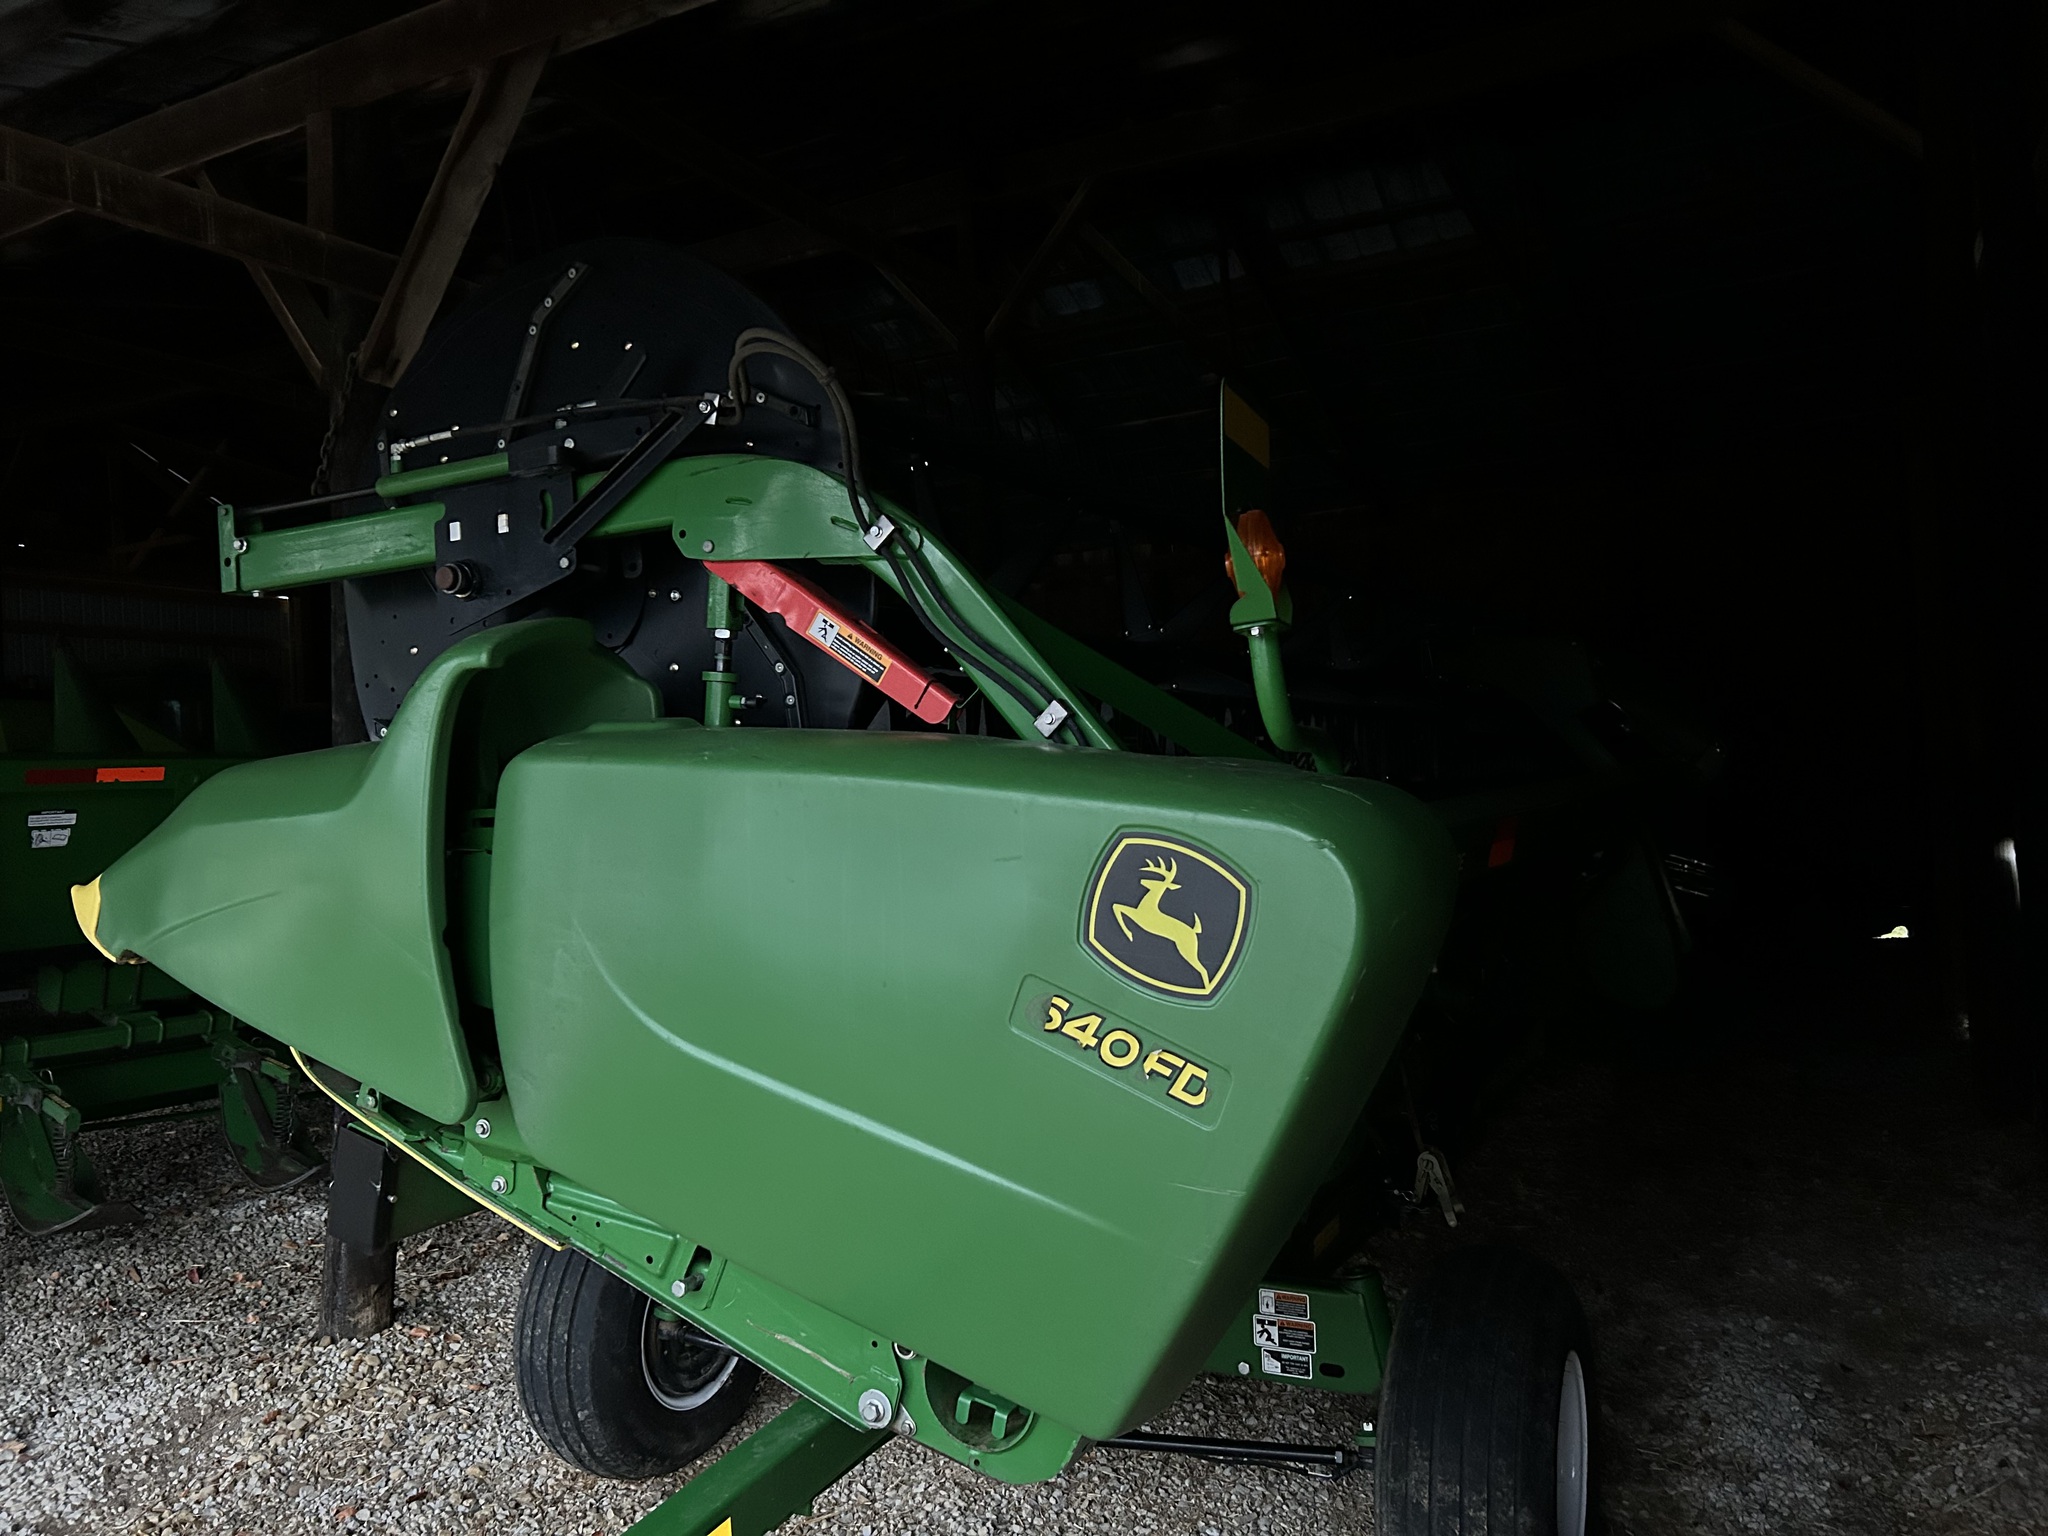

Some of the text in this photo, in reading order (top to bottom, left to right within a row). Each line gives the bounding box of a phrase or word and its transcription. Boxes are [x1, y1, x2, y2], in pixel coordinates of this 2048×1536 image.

[854, 637, 883, 661] WARNING
[1142, 1049, 1209, 1108] FD
[1281, 1295, 1306, 1303] WARNING
[1286, 1321, 1312, 1330] WARNING
[1281, 1353, 1308, 1362] IMPORTANT
